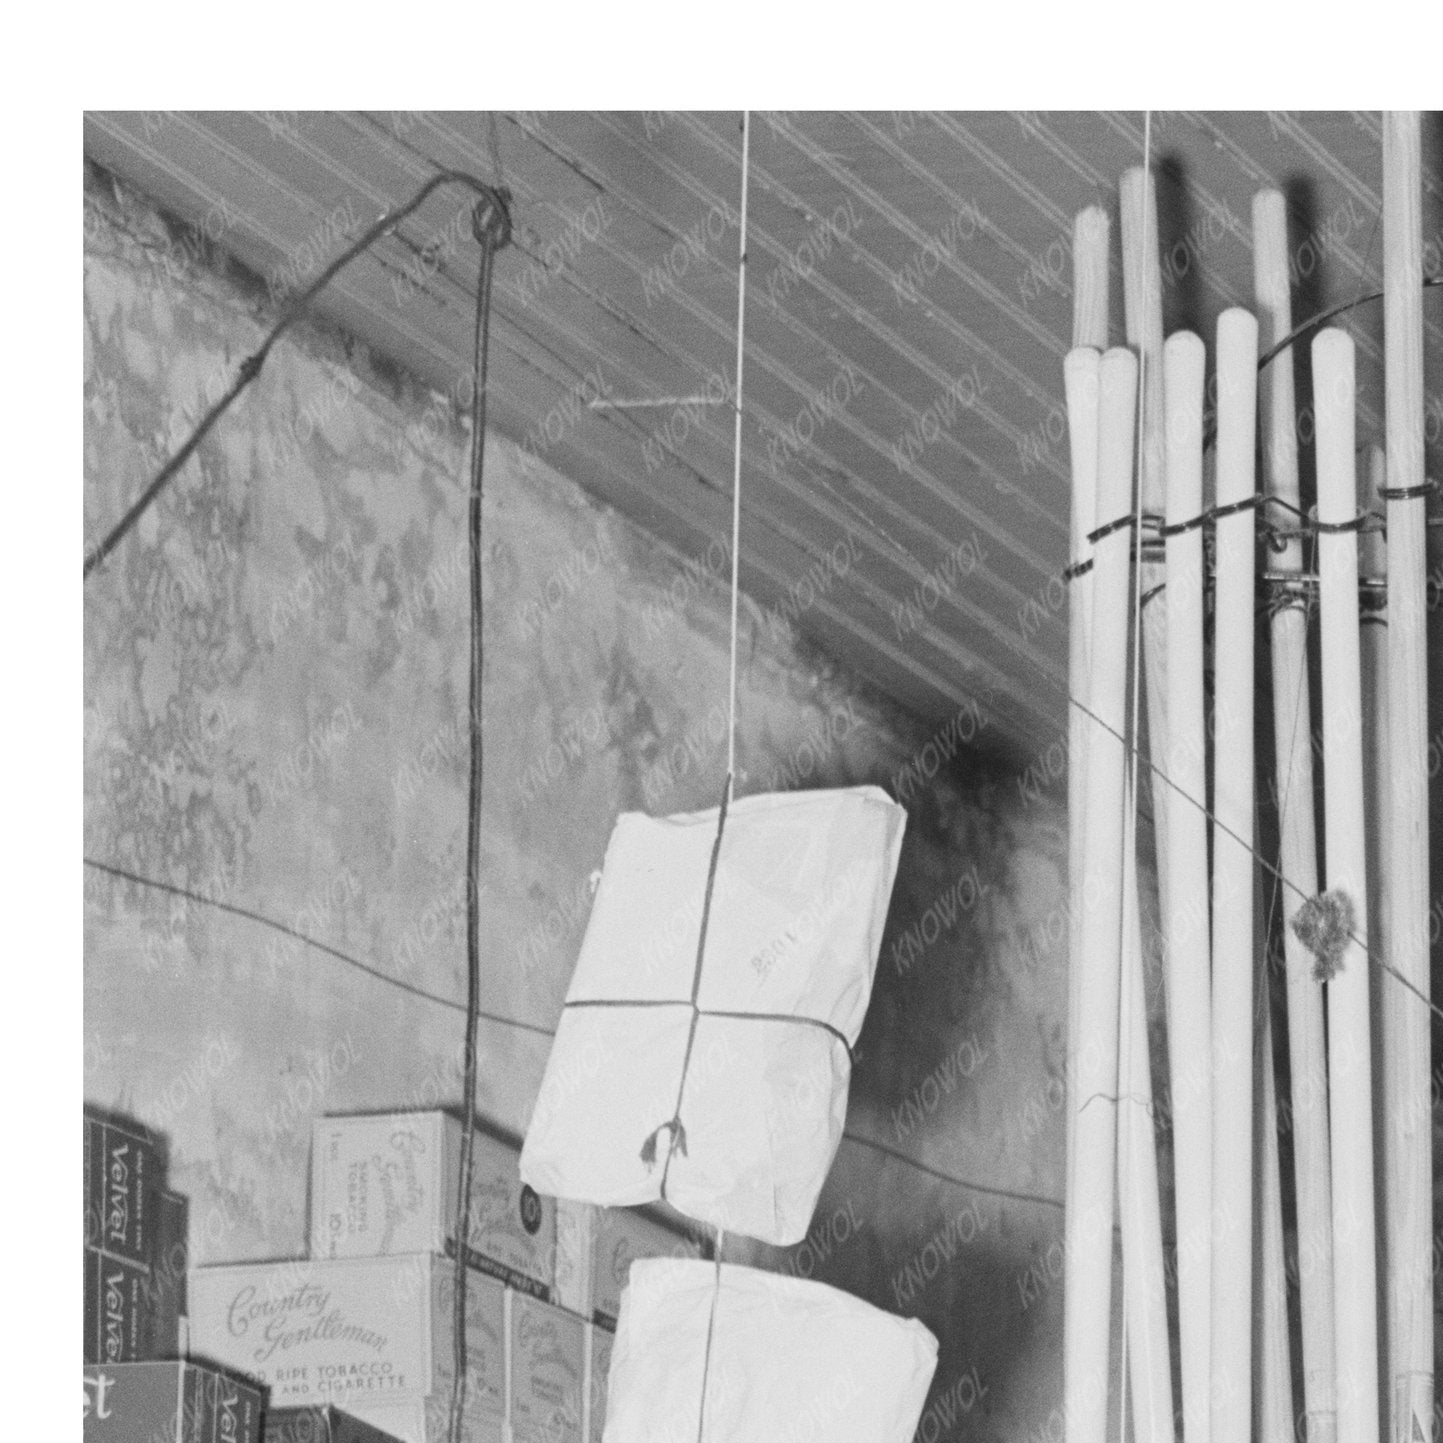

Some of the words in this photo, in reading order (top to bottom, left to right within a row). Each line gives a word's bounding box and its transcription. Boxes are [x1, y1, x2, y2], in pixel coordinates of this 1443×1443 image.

[111, 1143, 129, 1245] Velvet
[226, 1282, 333, 1338] Country
[252, 1308, 388, 1364] Gentleman
[276, 1367, 309, 1381] RIPE
[317, 1361, 394, 1378] TOBACCO
[283, 1383, 309, 1395] AND
[317, 1374, 406, 1393] CIGARETTE
